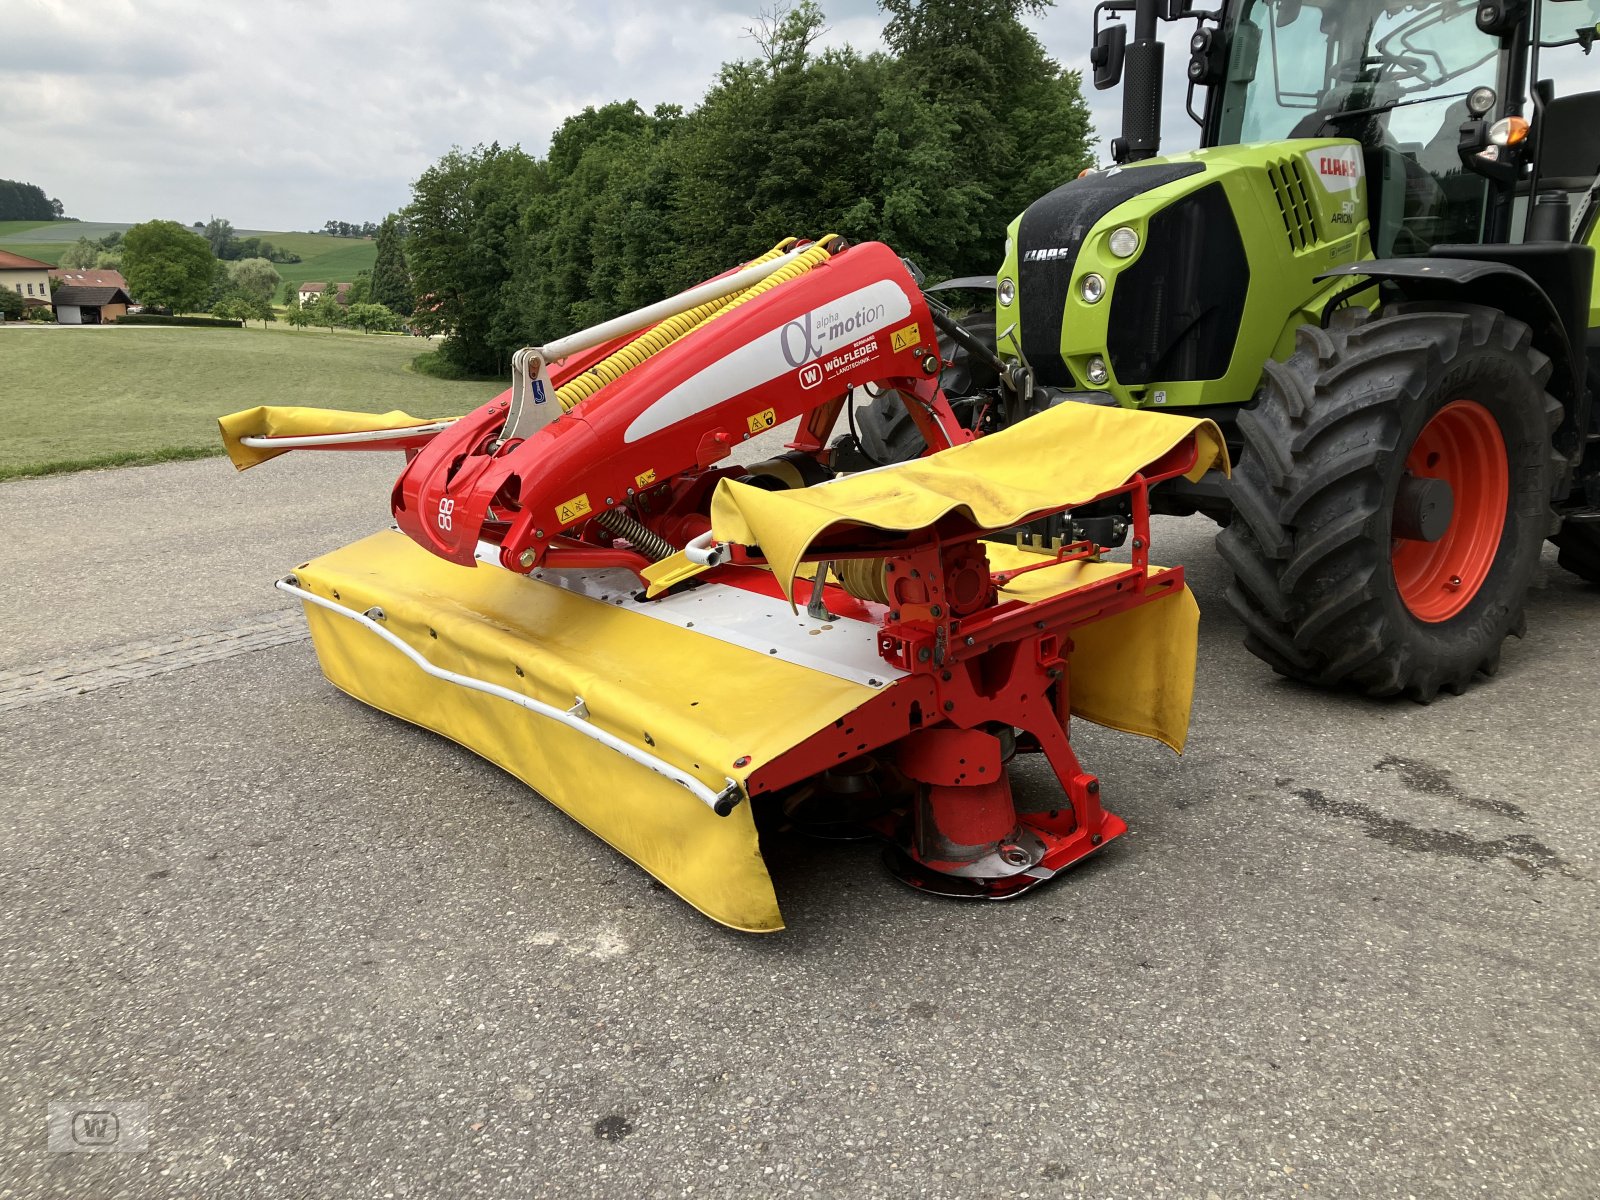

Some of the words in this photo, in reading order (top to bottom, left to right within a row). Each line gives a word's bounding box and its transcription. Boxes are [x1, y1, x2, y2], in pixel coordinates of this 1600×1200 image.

[1320, 157, 1357, 177] CLAAS
[1331, 213, 1353, 224] ARION
[816, 312, 839, 329] alpha
[824, 341, 878, 372] WÖLFLEDER
